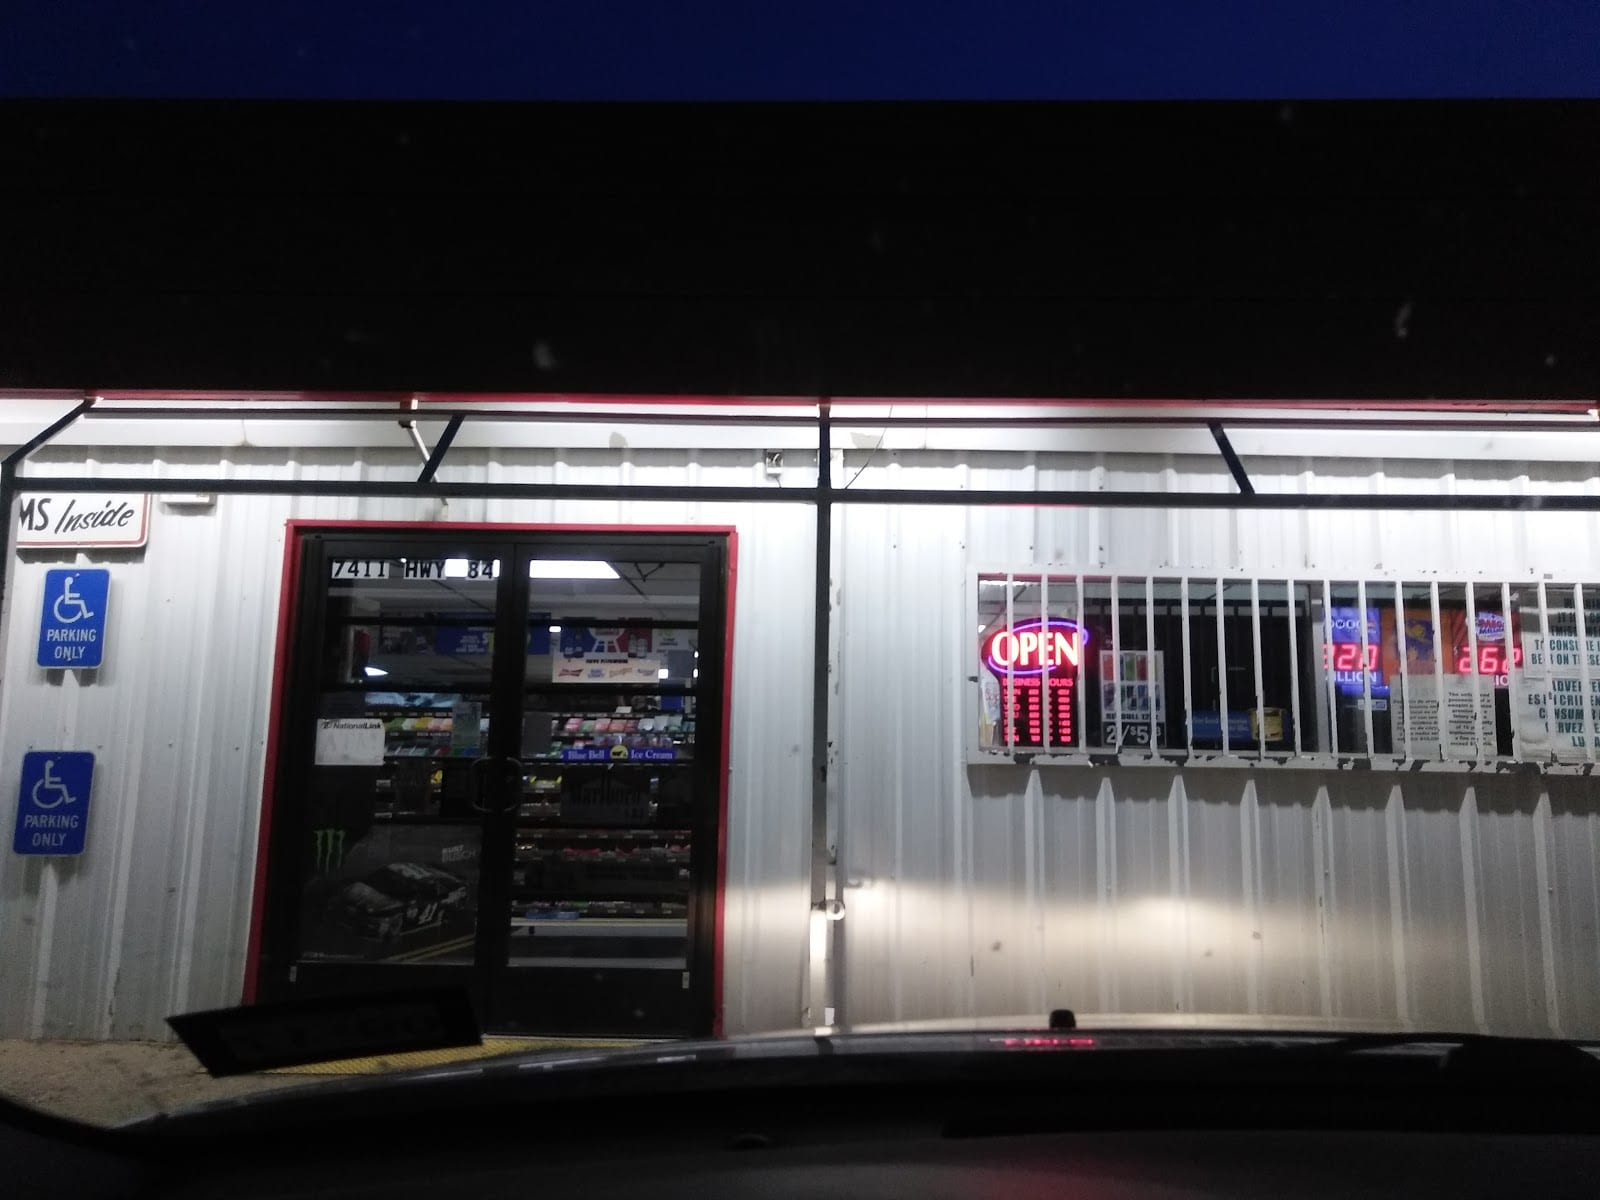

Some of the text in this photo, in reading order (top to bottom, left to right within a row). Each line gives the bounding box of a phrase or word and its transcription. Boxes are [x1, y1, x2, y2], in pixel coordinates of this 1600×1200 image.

[54, 500, 135, 534] Inside
[333, 560, 493, 578] 7411 HWY 84
[46, 628, 97, 642] PARKING
[991, 631, 1079, 666] OPEN
[1549, 639, 1594, 651] CONSE
[53, 645, 86, 660] ONLY
[1531, 653, 1600, 666] BE ON TSE
[1002, 677, 1074, 687] BSINESS OURS
[1326, 671, 1377, 682] ILLION
[1528, 694, 1541, 705] ES
[1560, 695, 1600, 707] CRIEN
[1539, 708, 1595, 721] CNSUM
[333, 722, 381, 730] NationalLink
[567, 749, 673, 760] Blue Bell Ice Cream
[24, 814, 80, 829] PARKING
[31, 832, 67, 847] ONLY
